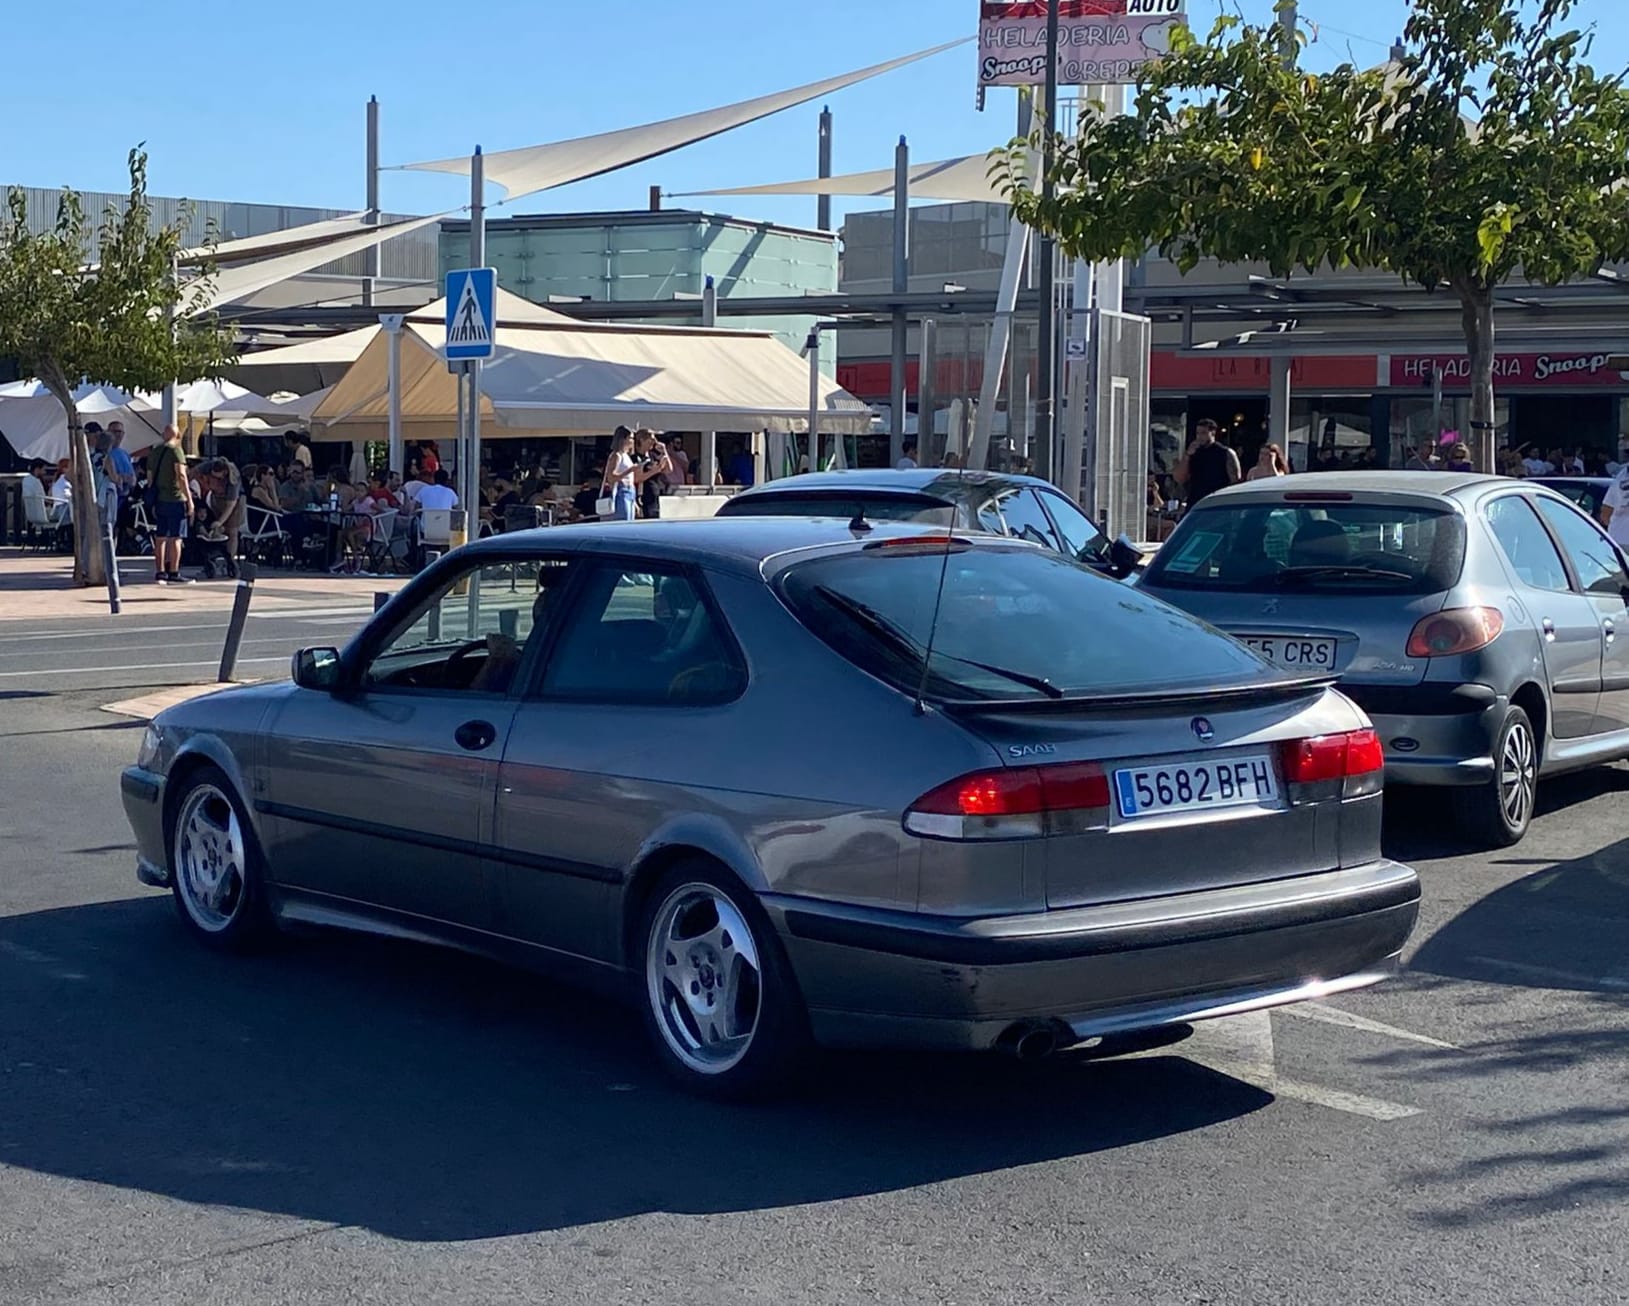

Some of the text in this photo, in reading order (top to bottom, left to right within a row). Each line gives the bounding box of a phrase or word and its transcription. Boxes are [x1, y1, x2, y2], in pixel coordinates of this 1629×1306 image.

[984, 25, 1130, 48] HELADERIA
[982, 54, 1061, 80] Snoop
[1404, 355, 1605, 380] HELADRIA Snoop
[1285, 641, 1329, 664] CRS
[1135, 767, 1213, 807] 5682
[1216, 760, 1270, 799] BFH
